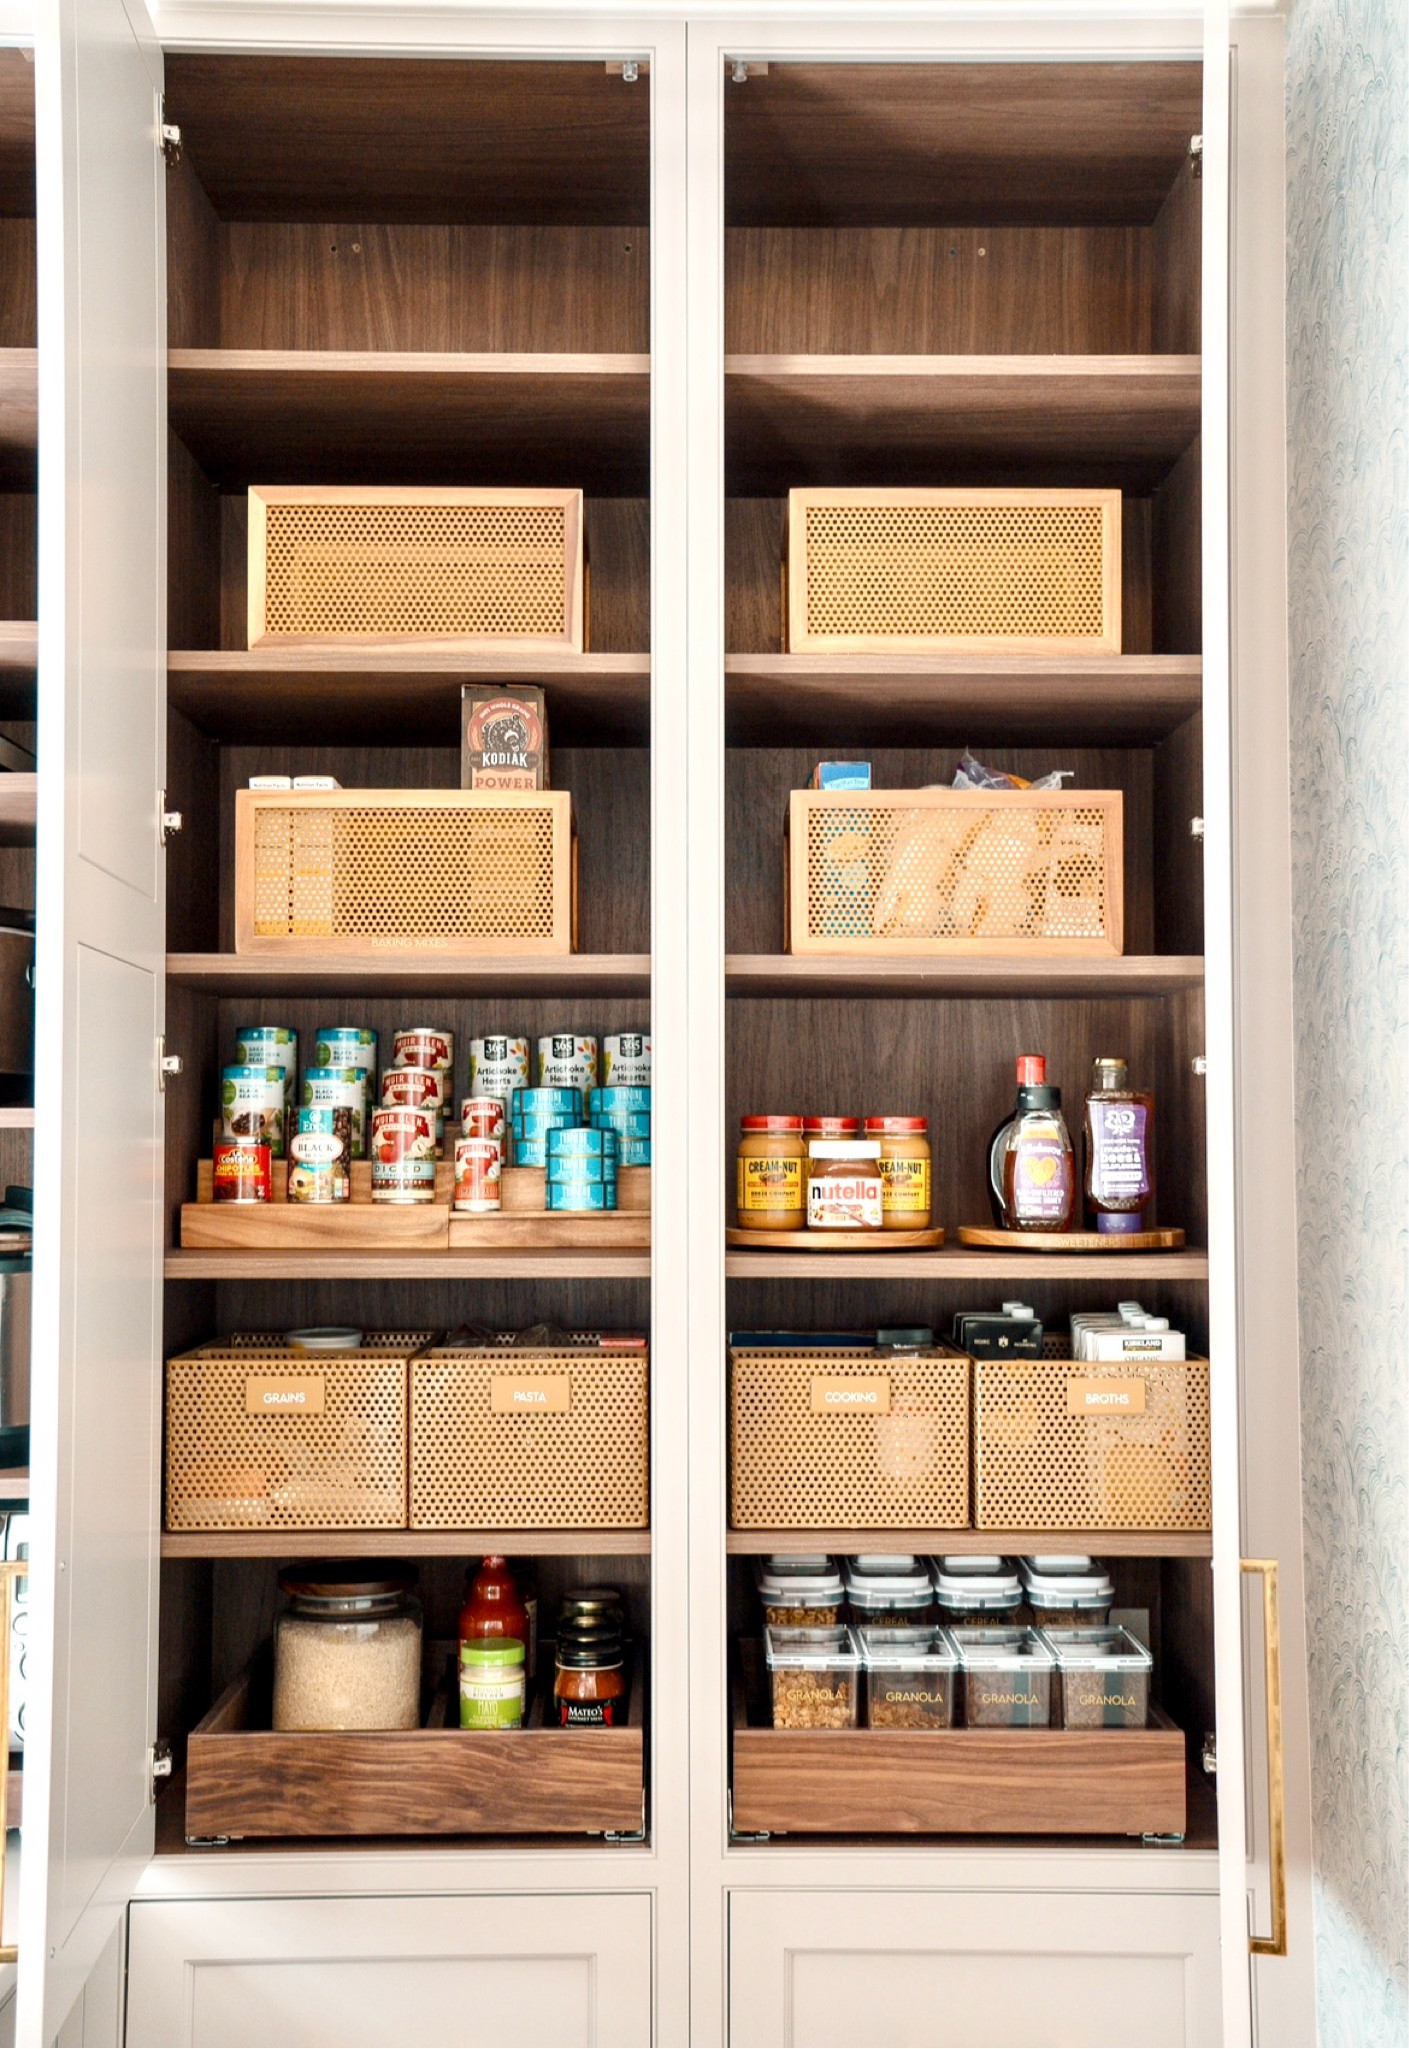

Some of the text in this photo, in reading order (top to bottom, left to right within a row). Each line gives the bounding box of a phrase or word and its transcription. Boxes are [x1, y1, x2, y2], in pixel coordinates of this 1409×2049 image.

[482, 751, 528, 768] KODIAK
[475, 777, 534, 789] POWER
[371, 937, 449, 947] BAKING MIXES
[485, 1042, 505, 1052] 365
[553, 1041, 572, 1051] 365
[621, 1040, 640, 1050] 365
[477, 1066, 517, 1076] Artichoke
[545, 1065, 585, 1074] Artichoke
[385, 1075, 405, 1086] MUIR
[482, 1077, 511, 1085] Hearts
[550, 1075, 579, 1083] Hearts
[617, 1073, 646, 1082] Hearts
[375, 1114, 395, 1127] MUIR
[298, 1143, 333, 1152] BLACK
[375, 1165, 421, 1173] DICED
[748, 1161, 798, 1174] CREAM-NUT
[879, 1161, 922, 1175] REAM-NUT
[812, 1181, 877, 1199] nutella
[1054, 1237, 1122, 1248] SWEETENERS
[263, 1392, 306, 1404] GRAINS
[513, 1391, 546, 1402] PASTA
[824, 1391, 878, 1403] COOKING
[1085, 1393, 1129, 1405] BROTHS
[871, 1615, 910, 1626] CEREAL
[786, 1689, 843, 1701] GRANOLA
[885, 1691, 943, 1703] GRANOLA
[982, 1693, 1039, 1705] GRANOLA
[1079, 1694, 1136, 1706] GRANOLA
[477, 1700, 498, 1715] MAYO
